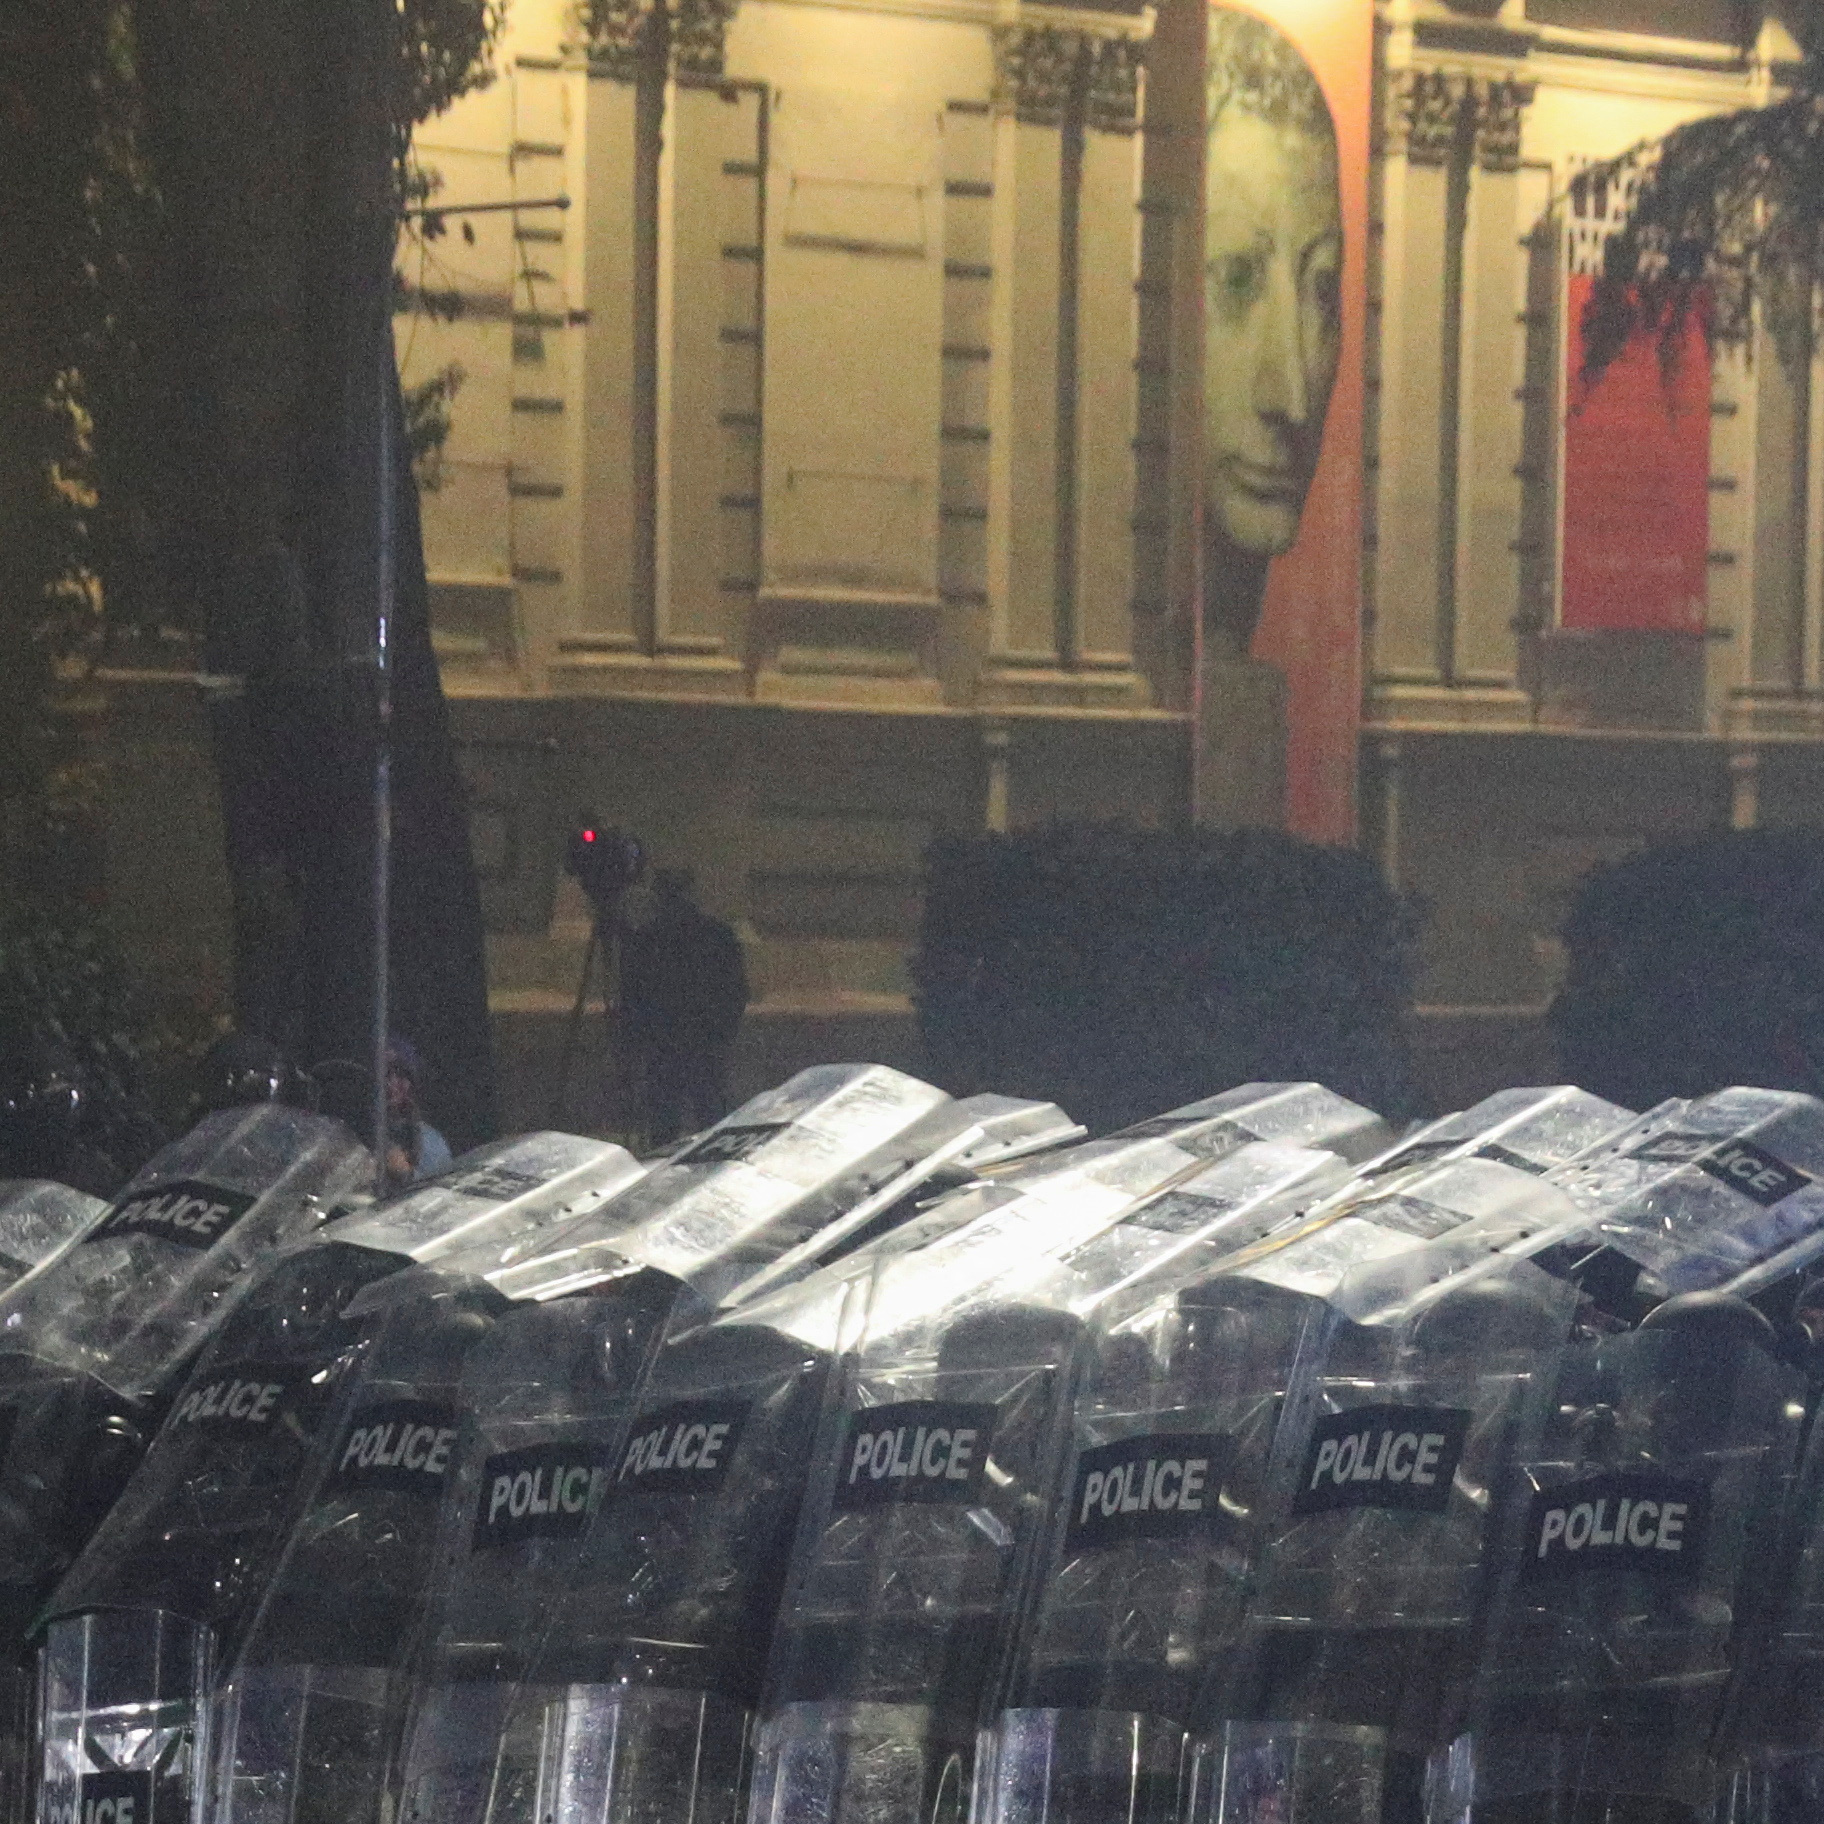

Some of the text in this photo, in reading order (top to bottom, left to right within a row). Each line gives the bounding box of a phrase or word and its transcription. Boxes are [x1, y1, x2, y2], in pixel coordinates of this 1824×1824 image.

[112, 1191, 230, 1235] POLICE
[170, 1379, 283, 1431] POLICE
[338, 1422, 457, 1475] POLICE
[617, 1423, 729, 1482] POLICE
[849, 1426, 976, 1485] POLICE
[1311, 1431, 1445, 1490] POLICE
[1081, 1458, 1208, 1524] POLICE
[1537, 1498, 1688, 1558] POLICE
